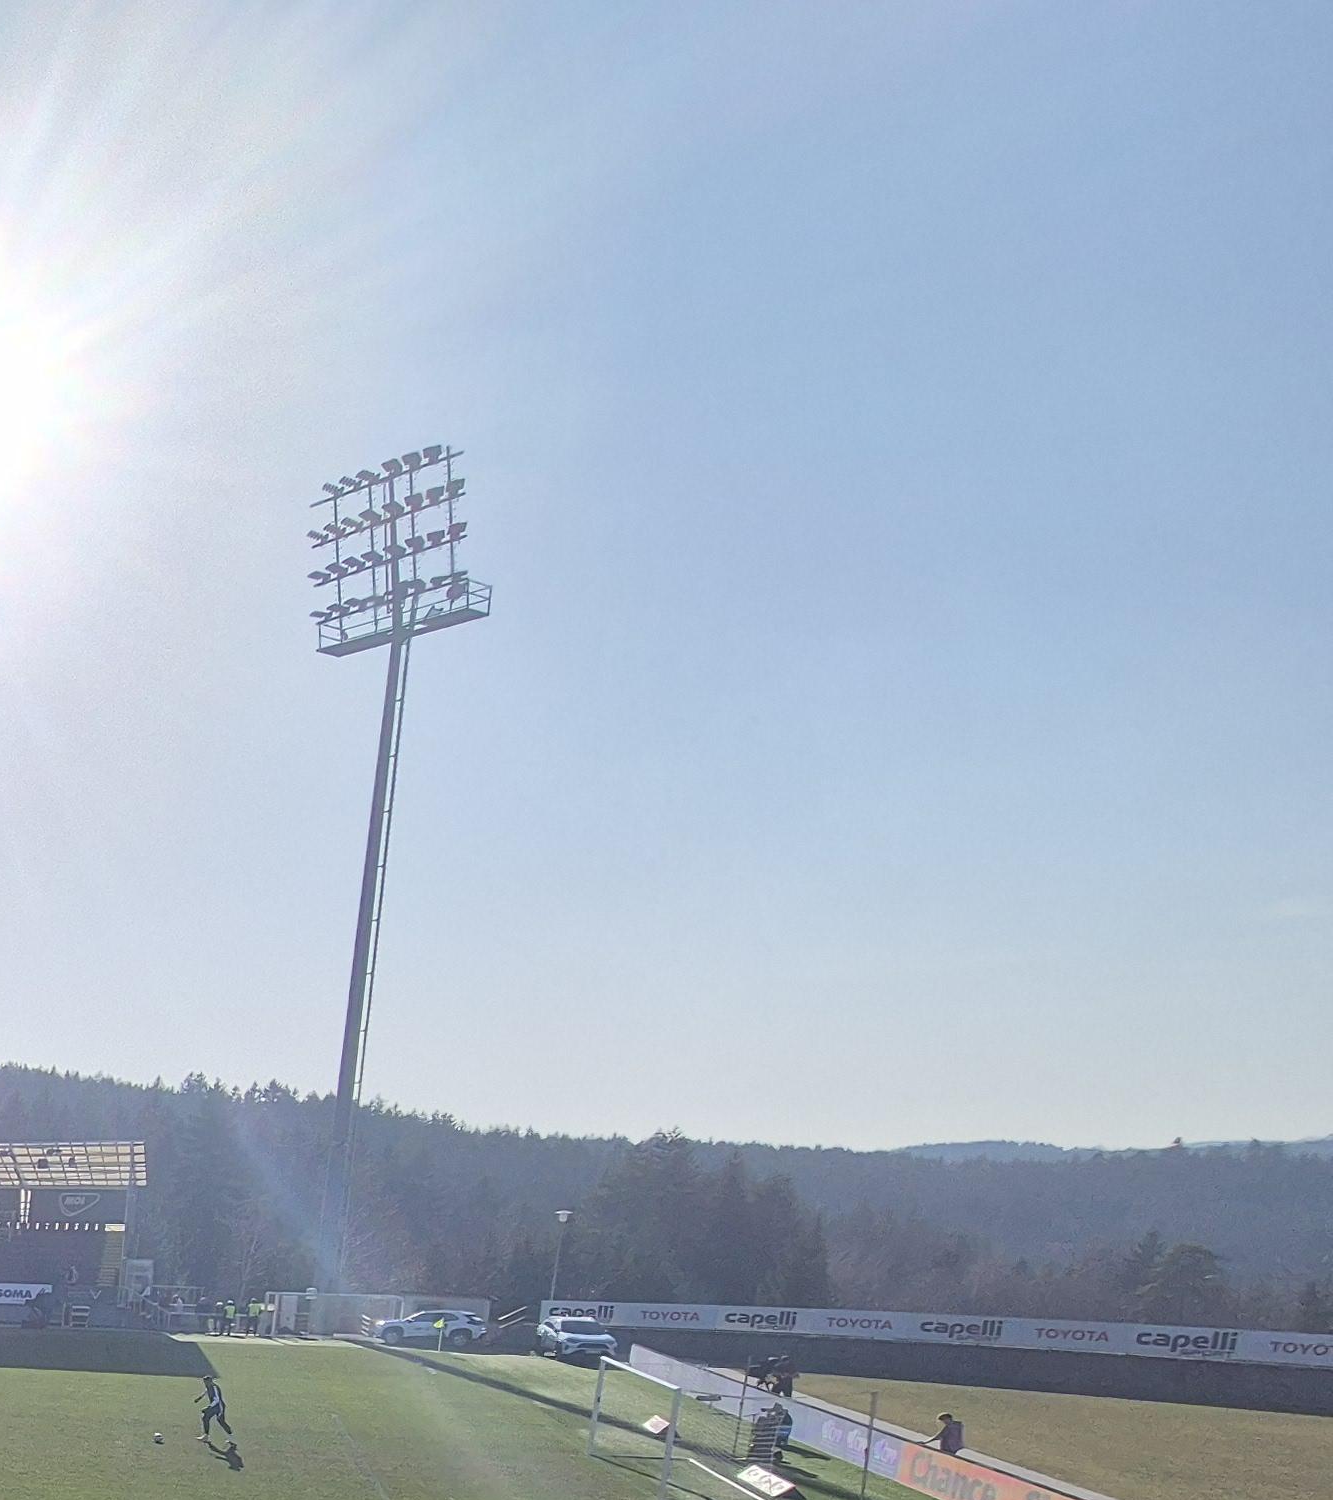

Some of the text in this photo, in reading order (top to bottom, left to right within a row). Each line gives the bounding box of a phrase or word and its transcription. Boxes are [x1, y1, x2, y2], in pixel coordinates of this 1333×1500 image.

[548, 1305, 615, 1320] capelli
[640, 1310, 700, 1322] TOYOTA
[724, 1309, 798, 1329] capelli
[827, 1316, 893, 1330] TOYOTA
[919, 1319, 1003, 1339] capelli
[1034, 1327, 1110, 1343] TOYOTA
[1135, 1331, 1238, 1355] capelli
[1269, 1340, 1333, 1357] TOYO
